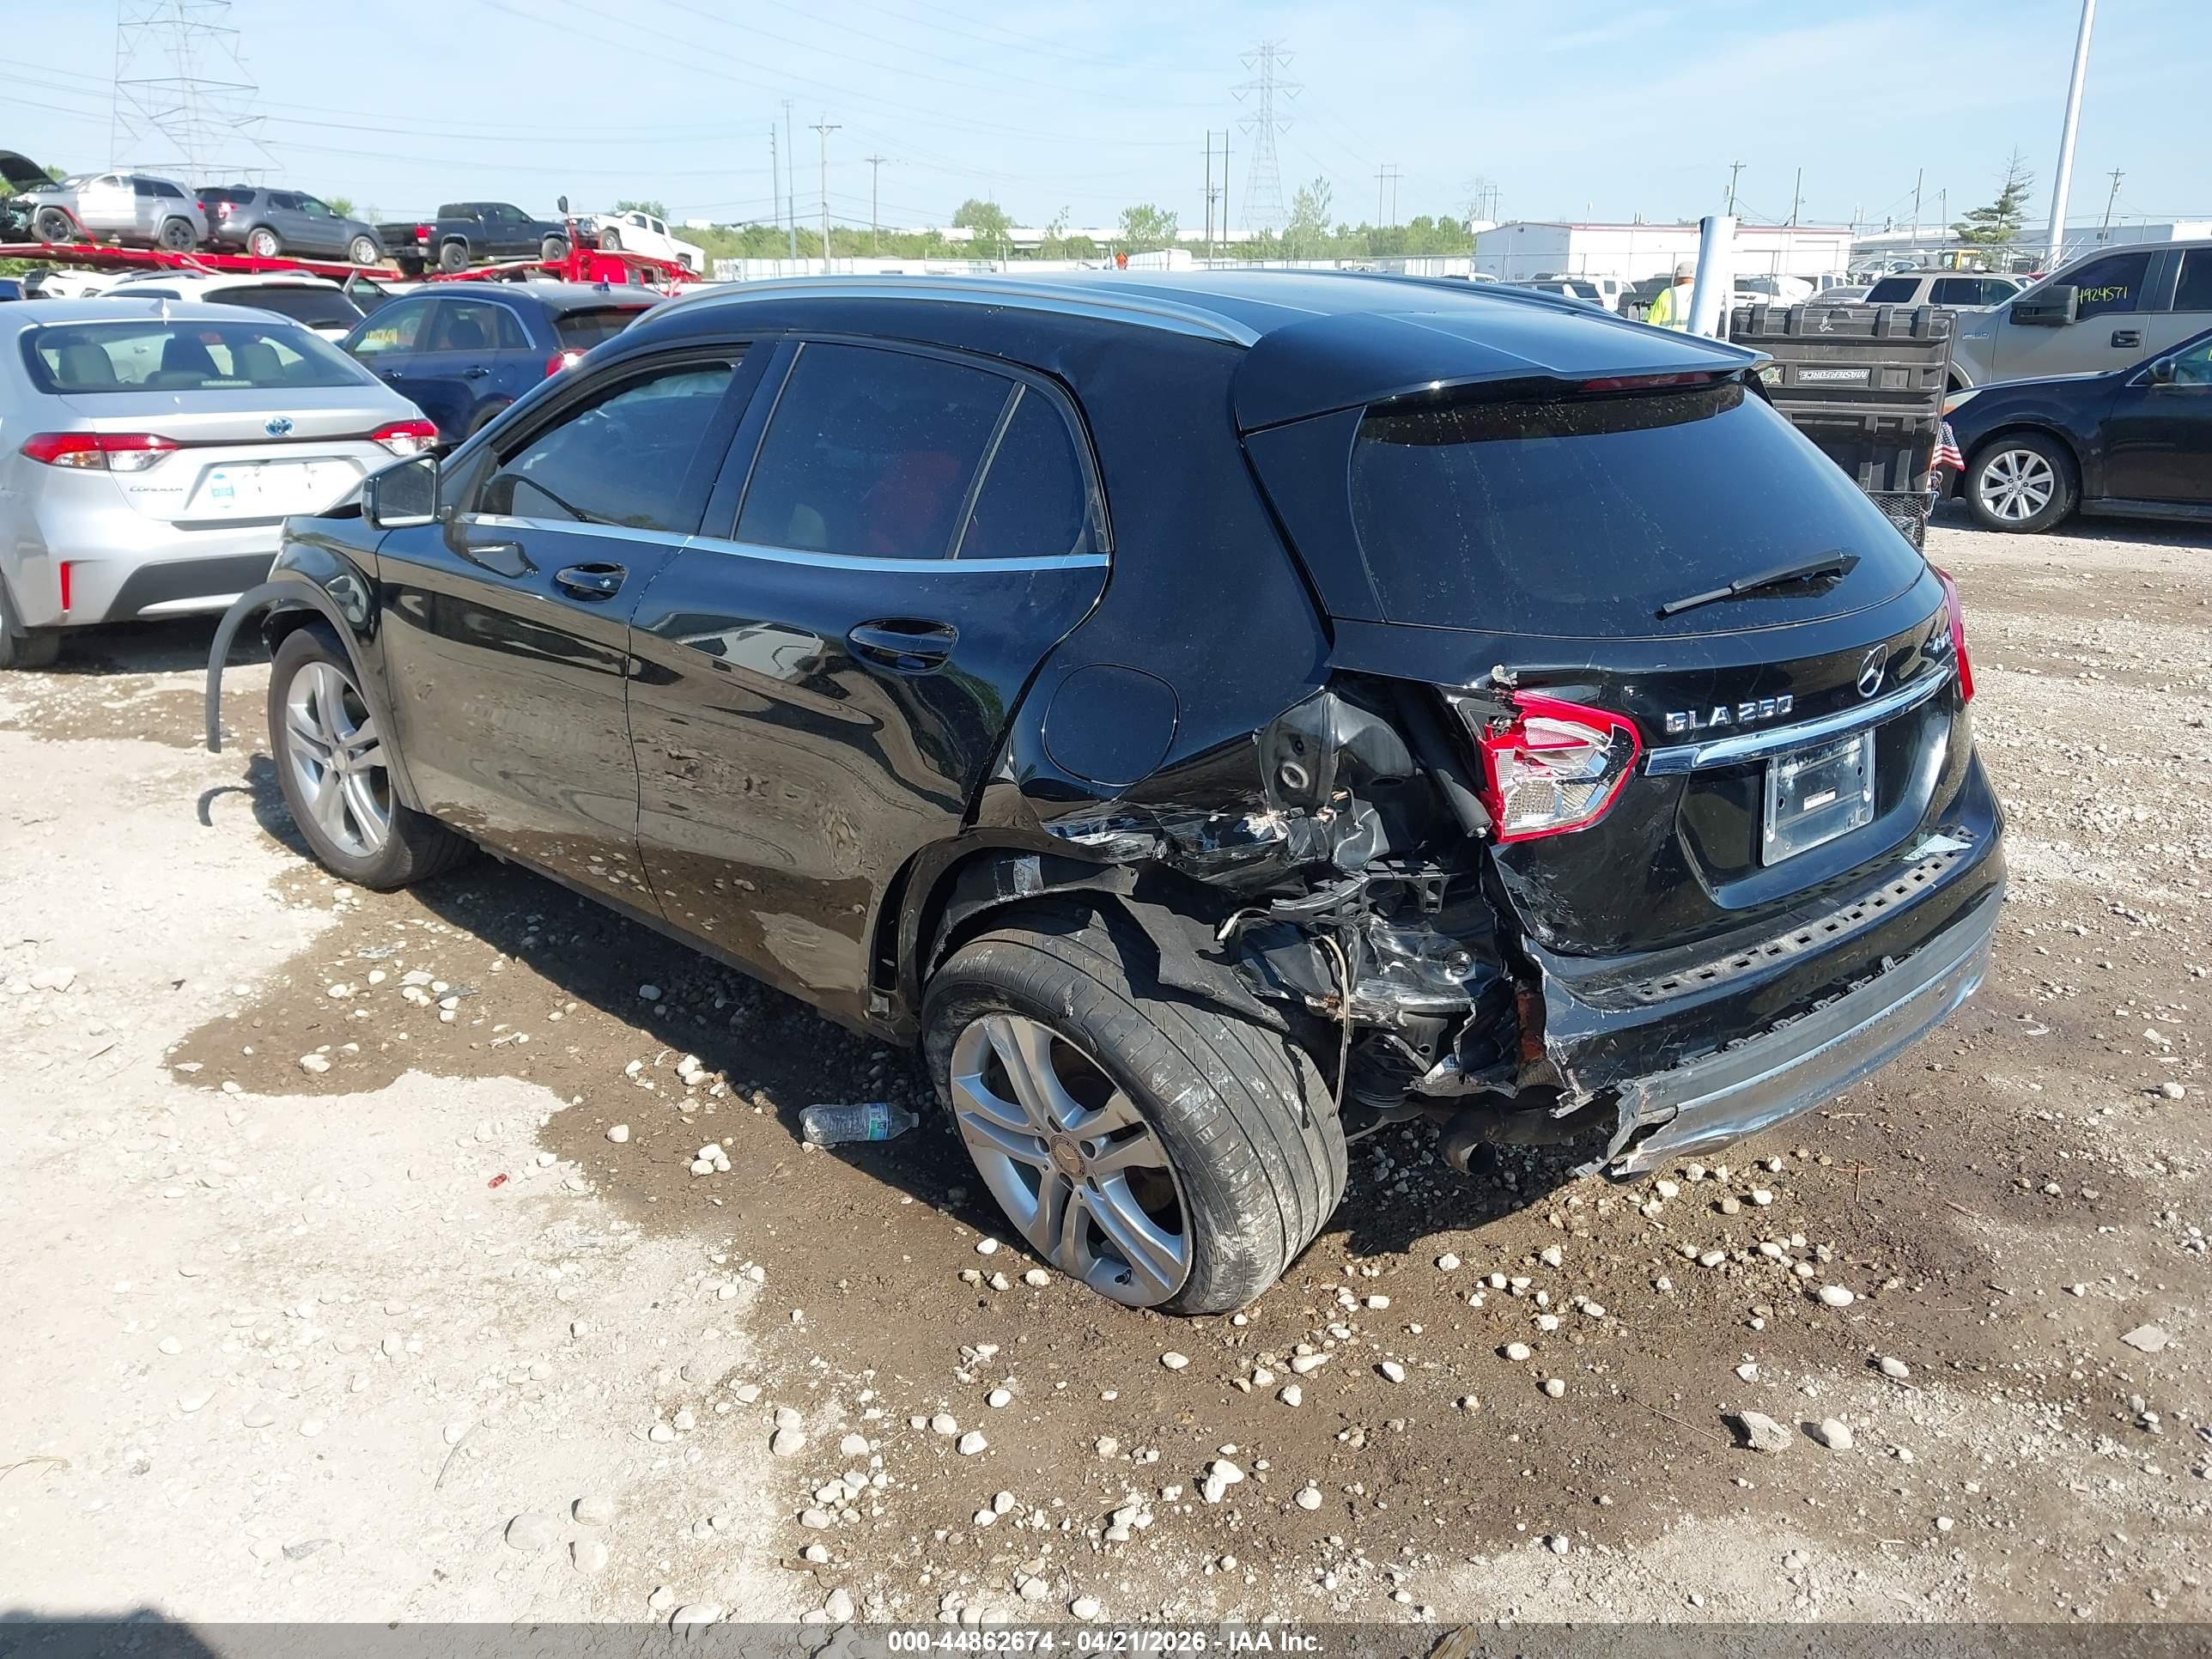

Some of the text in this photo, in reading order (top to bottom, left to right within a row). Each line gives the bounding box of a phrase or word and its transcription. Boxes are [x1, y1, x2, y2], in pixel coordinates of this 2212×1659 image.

[1799, 368, 1870, 380] MASTERFORCE
[1665, 693, 1794, 734] GLA 250
